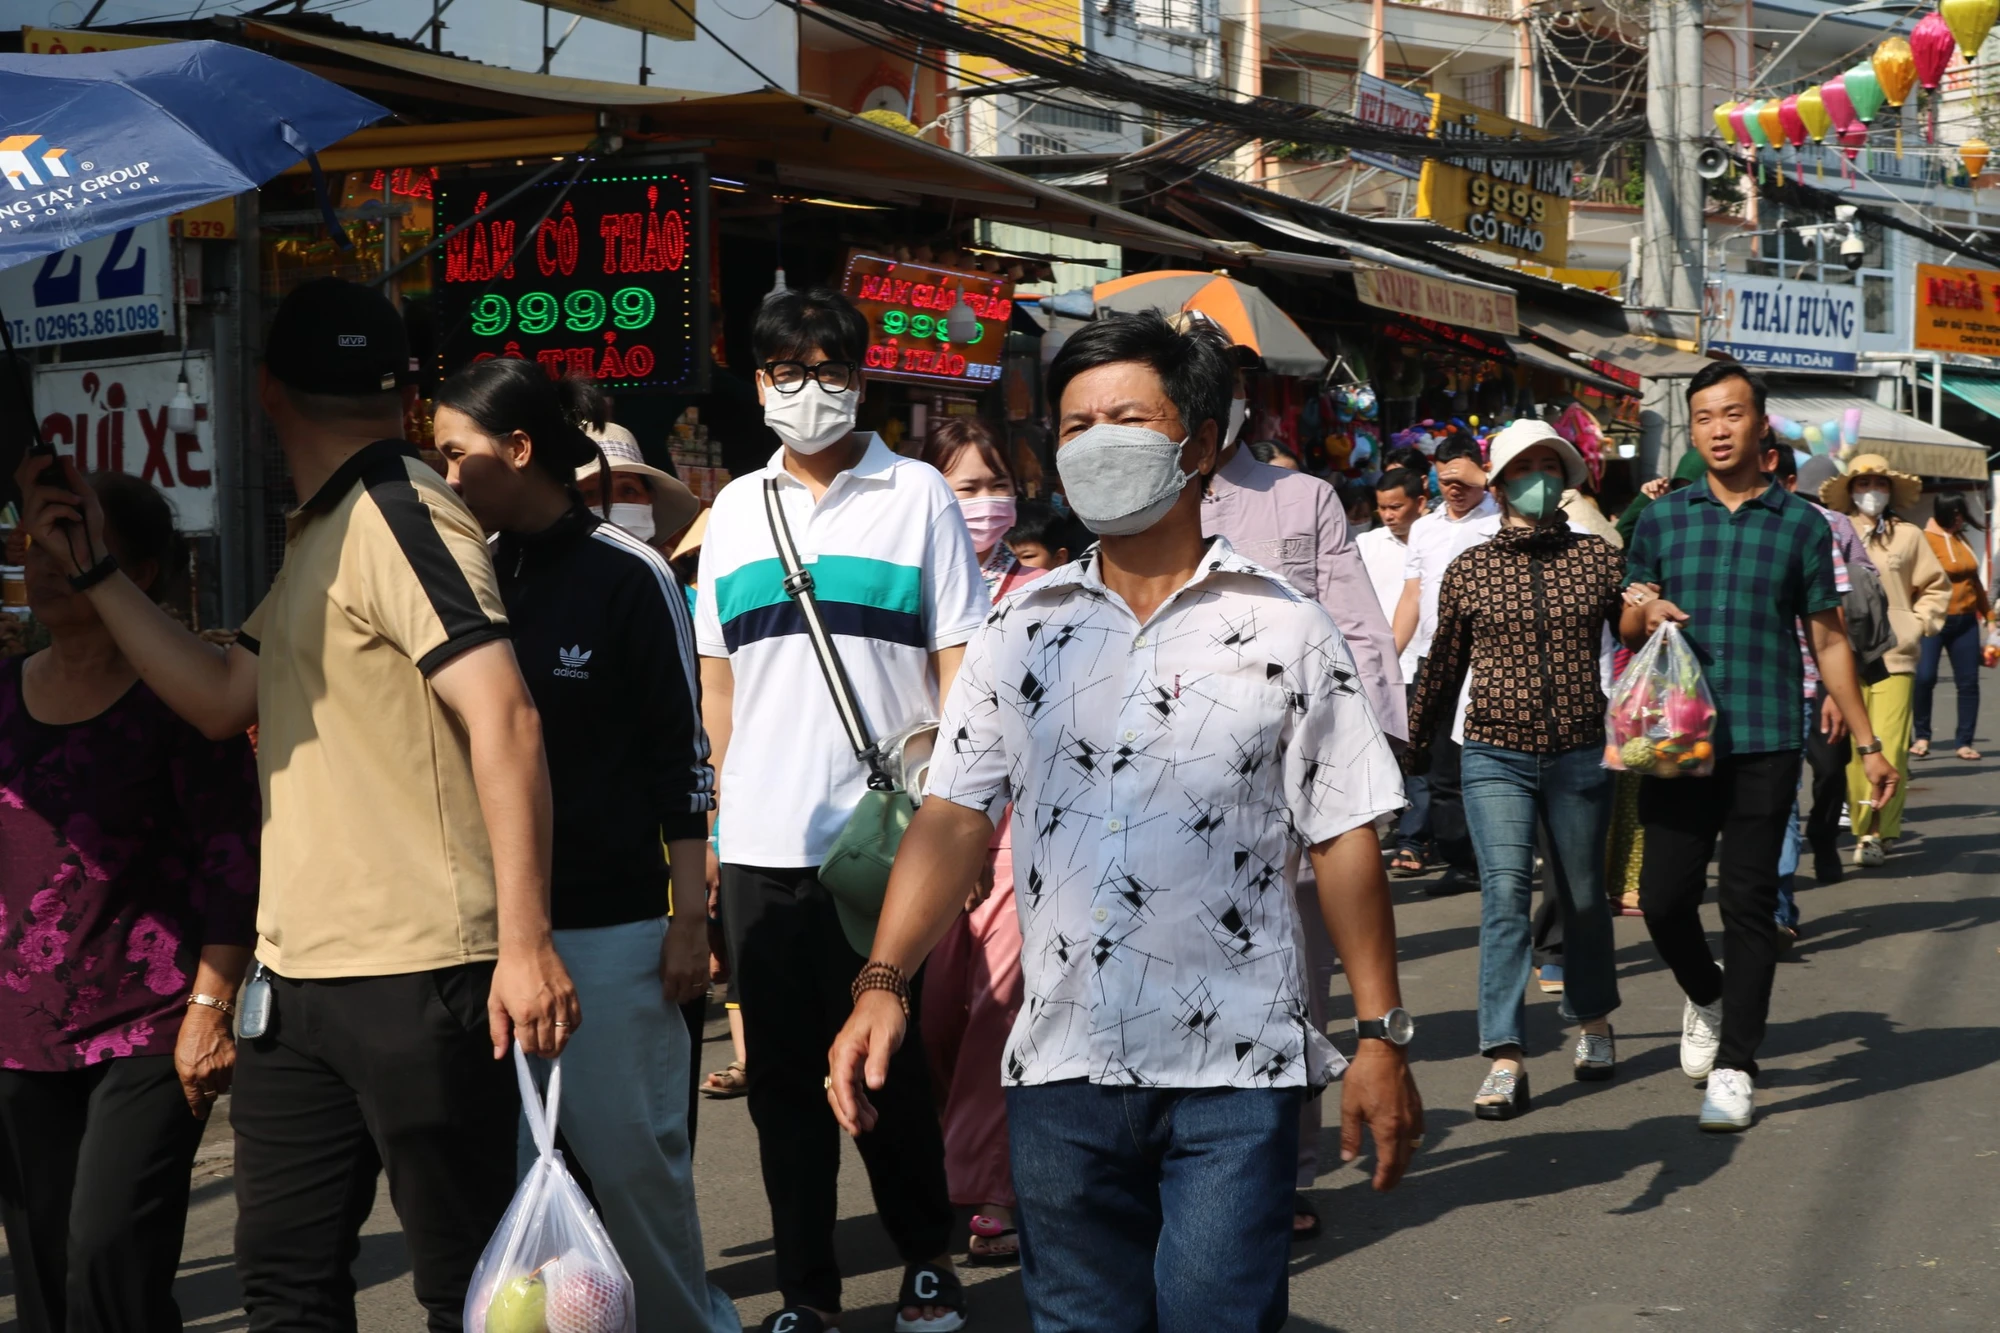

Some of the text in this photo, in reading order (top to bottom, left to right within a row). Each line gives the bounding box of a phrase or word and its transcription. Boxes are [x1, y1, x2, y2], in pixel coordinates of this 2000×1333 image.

[0, 175, 161, 234] RPORATION
[32, 185, 74, 208] TAY
[80, 161, 150, 193] GROUP
[1471, 179, 1546, 223] 9999
[189, 220, 225, 237] 379
[536, 201, 579, 277] CÔ
[600, 185, 686, 275] THẢO
[1469, 210, 1546, 253] CÔ THẢO
[471, 287, 656, 336] 9999
[1741, 283, 1792, 334] THÁI
[1925, 271, 1985, 311] NHÀ
[35, 303, 159, 341] 02963.861098
[341, 337, 364, 345] MVP
[536, 331, 656, 381] THẢO
[865, 337, 899, 369] CÔ
[904, 343, 966, 376] THẢO
[1746, 351, 1767, 362] XE
[1770, 353, 1792, 364] AN
[1794, 352, 1834, 368] TOÀN
[137, 402, 213, 489] XE
[553, 666, 590, 680] adidas
[914, 1270, 939, 1299] C
